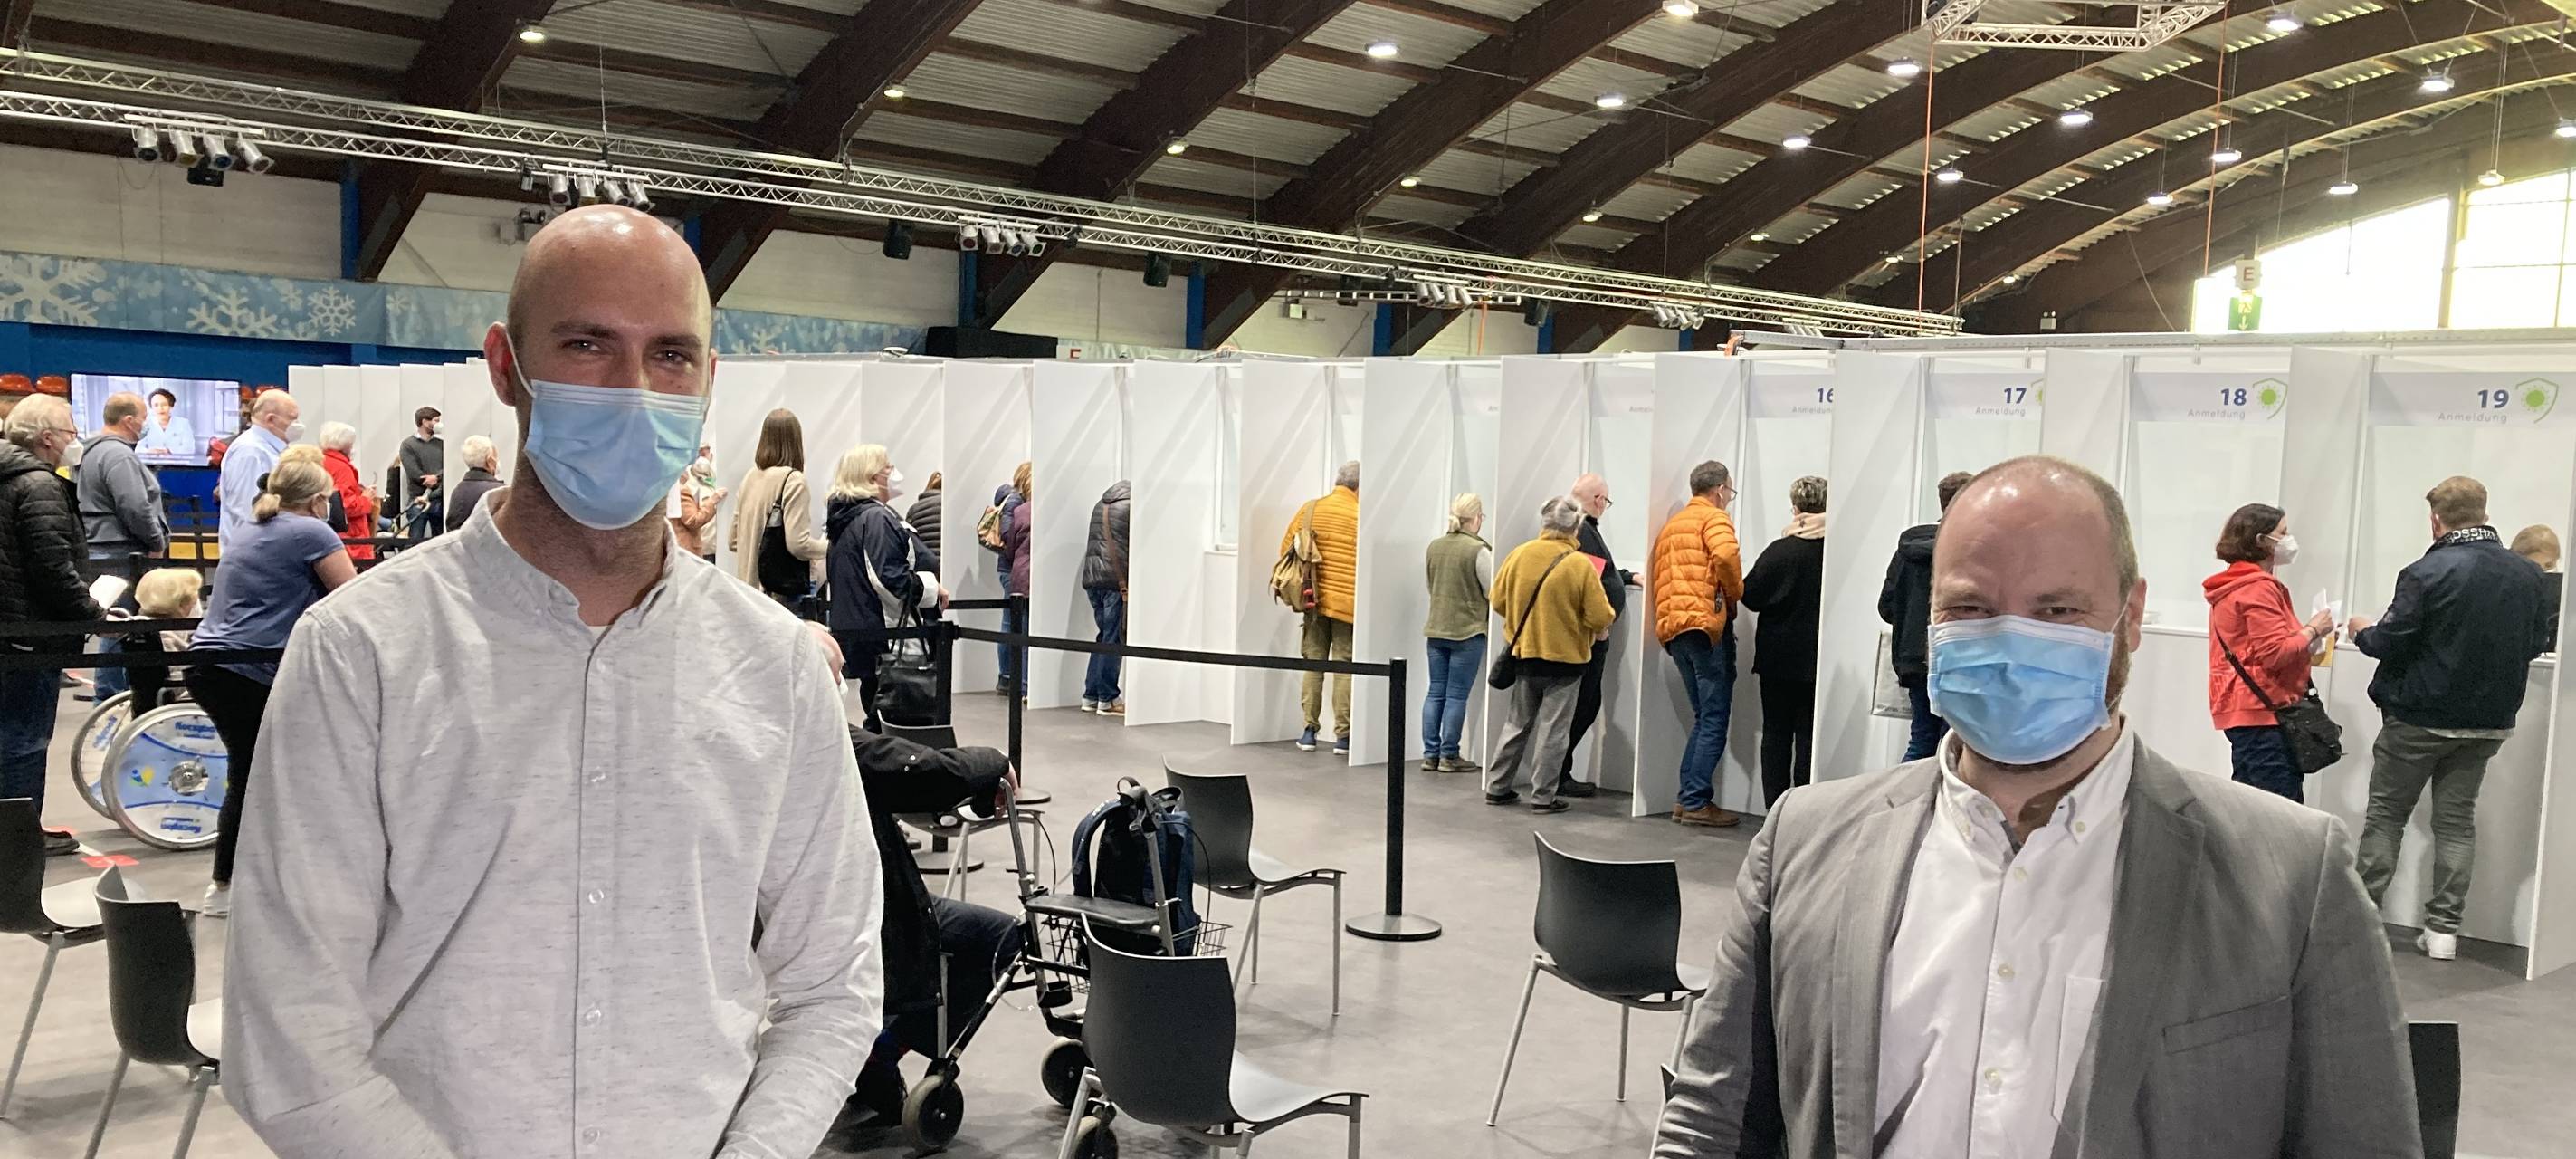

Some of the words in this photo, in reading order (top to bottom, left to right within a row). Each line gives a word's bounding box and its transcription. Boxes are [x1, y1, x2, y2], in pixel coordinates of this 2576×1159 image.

[2244, 266, 2255, 281] E
[1817, 388, 1834, 404] 16
[2004, 388, 2027, 404] 17
[2220, 388, 2247, 407] 18
[2477, 389, 2510, 408] 19
[1791, 406, 1833, 414] Anmeldun
[1974, 407, 2027, 417] Anmeldung
[2188, 408, 2246, 421] Anmeldung
[2438, 413, 2508, 425] Anmeldung
